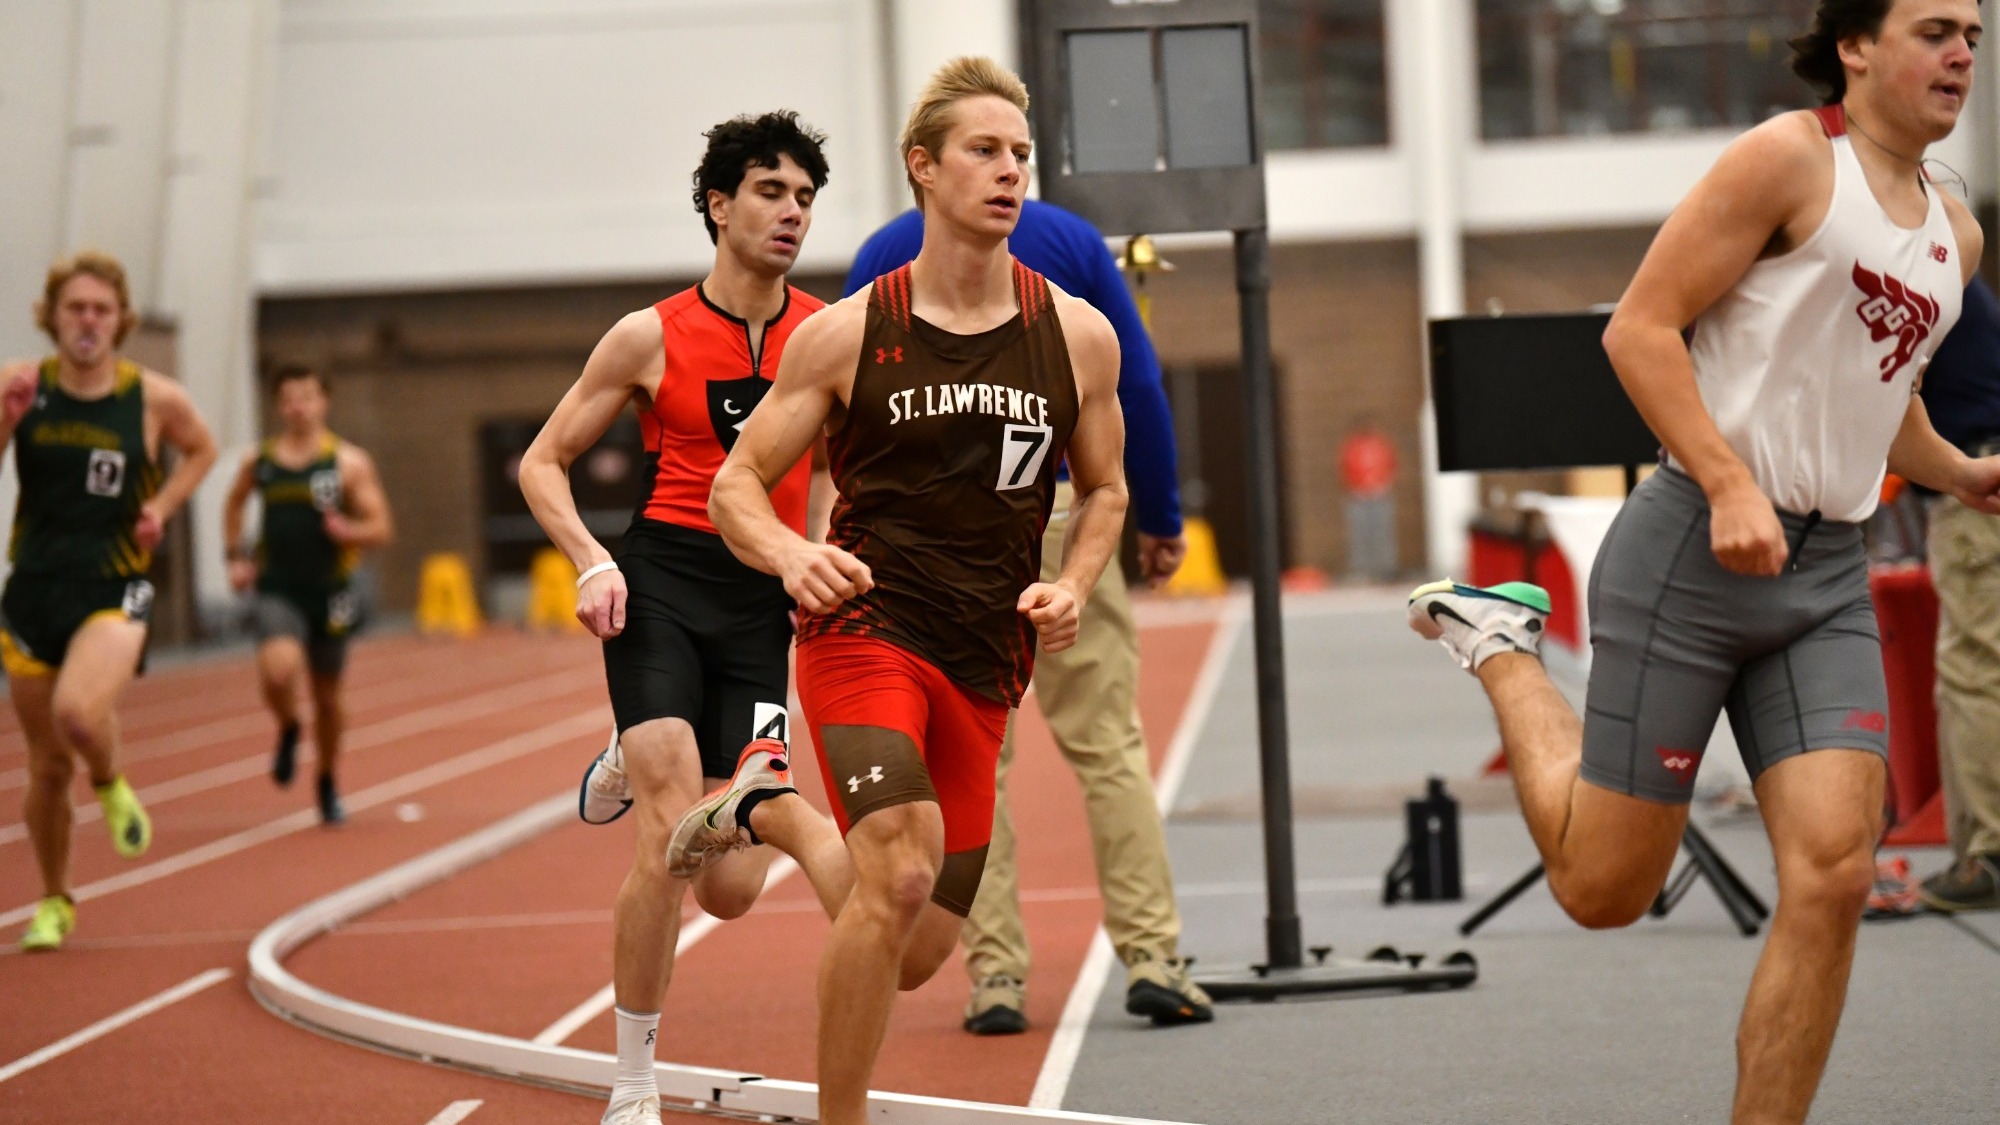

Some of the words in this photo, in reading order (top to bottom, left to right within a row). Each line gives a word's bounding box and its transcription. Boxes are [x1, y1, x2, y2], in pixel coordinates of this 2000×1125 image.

[888, 387, 921, 425] ST.
[924, 383, 1048, 427] LAWRENCE
[1006, 430, 1046, 486] 7
[755, 712, 786, 750] 4
